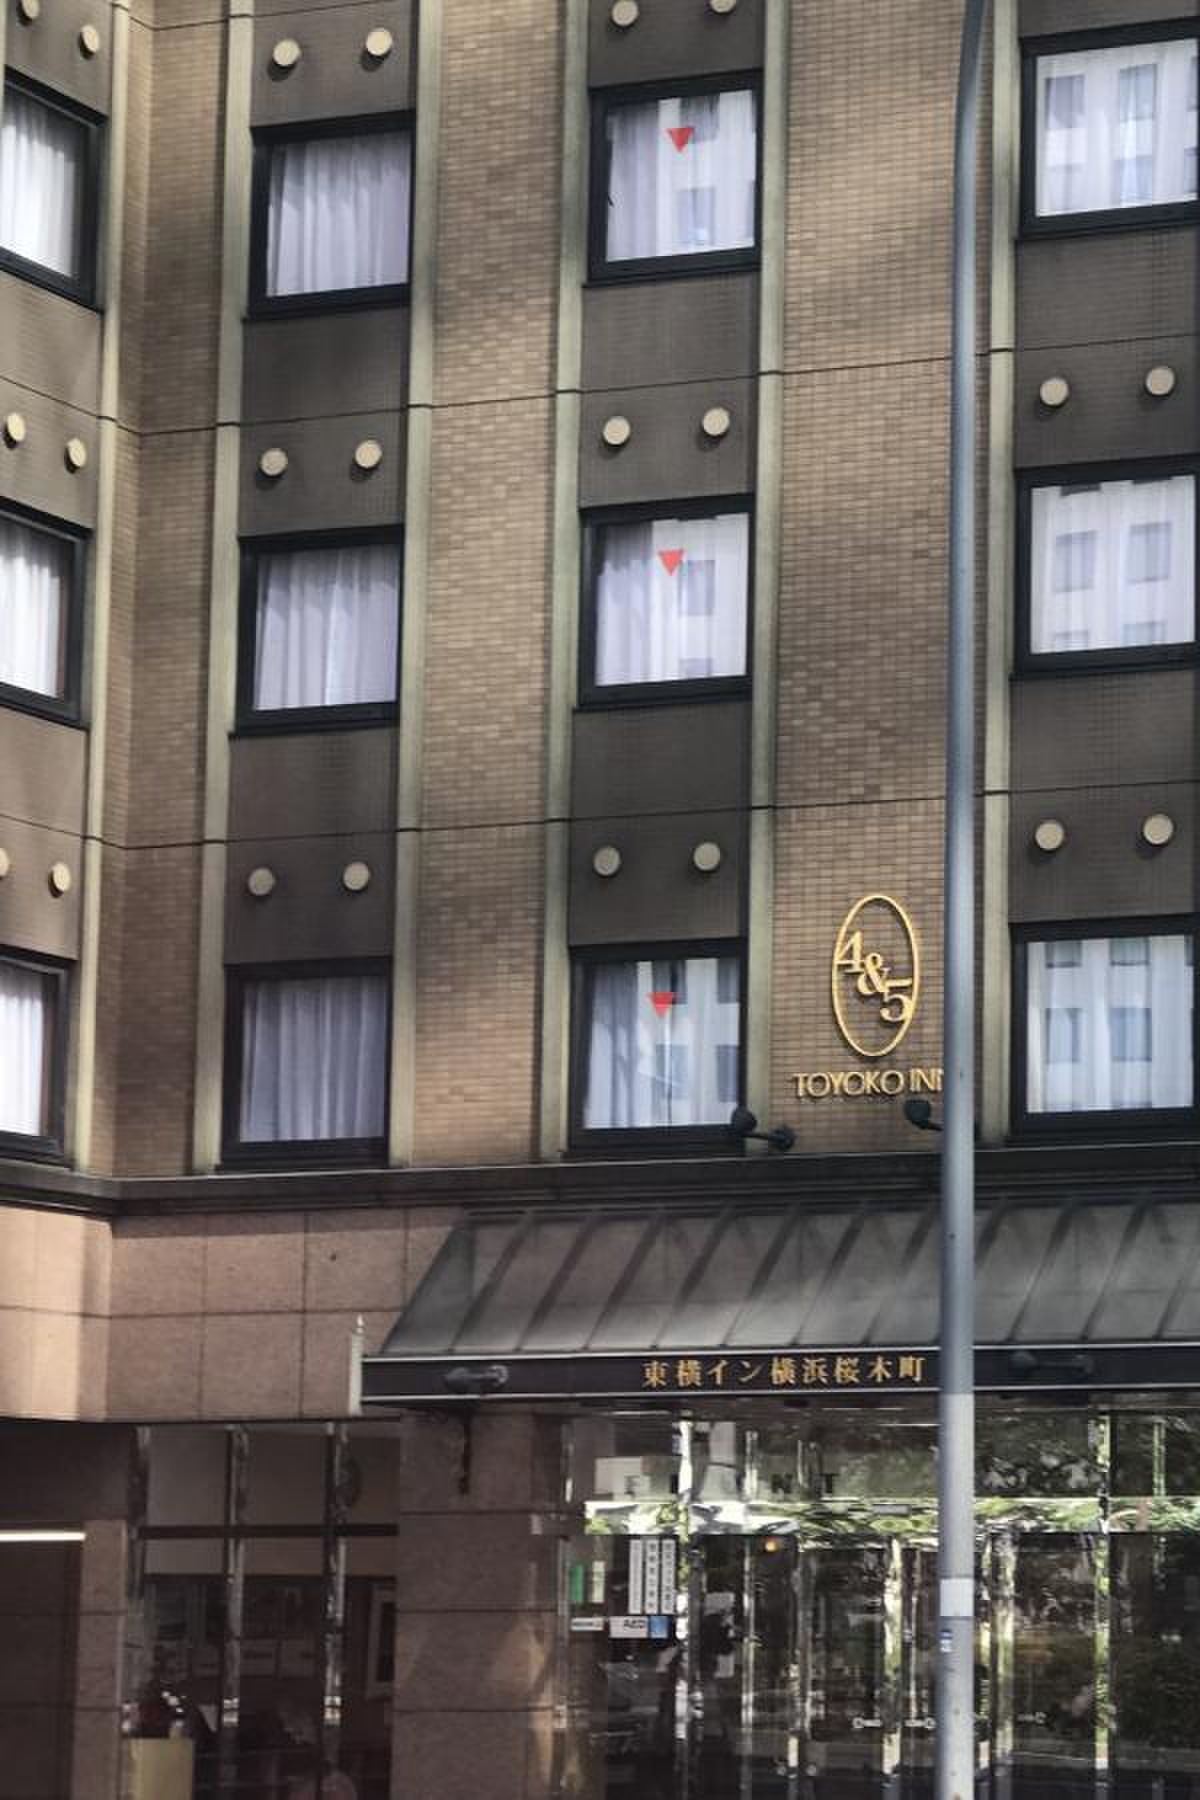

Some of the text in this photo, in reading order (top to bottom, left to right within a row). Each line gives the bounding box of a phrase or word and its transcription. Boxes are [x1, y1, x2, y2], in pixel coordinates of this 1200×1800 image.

[793, 1067, 943, 1098] TOYOKO IN
[642, 1356, 926, 1388] 東横イン横浜桜木町
